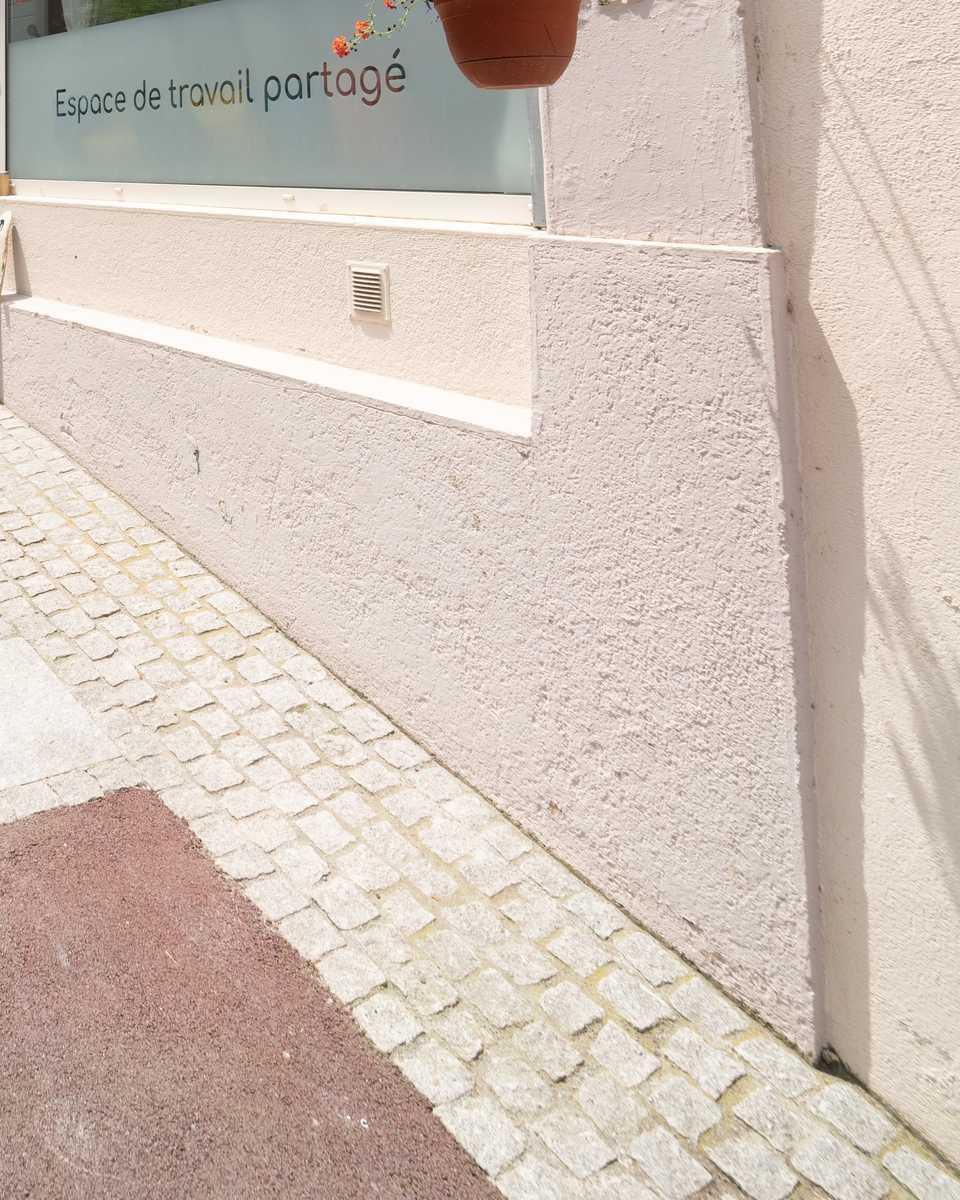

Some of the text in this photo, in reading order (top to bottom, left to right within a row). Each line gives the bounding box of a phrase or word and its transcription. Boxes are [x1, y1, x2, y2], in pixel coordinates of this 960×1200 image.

[56, 48, 407, 123] Espace de travail partagé
